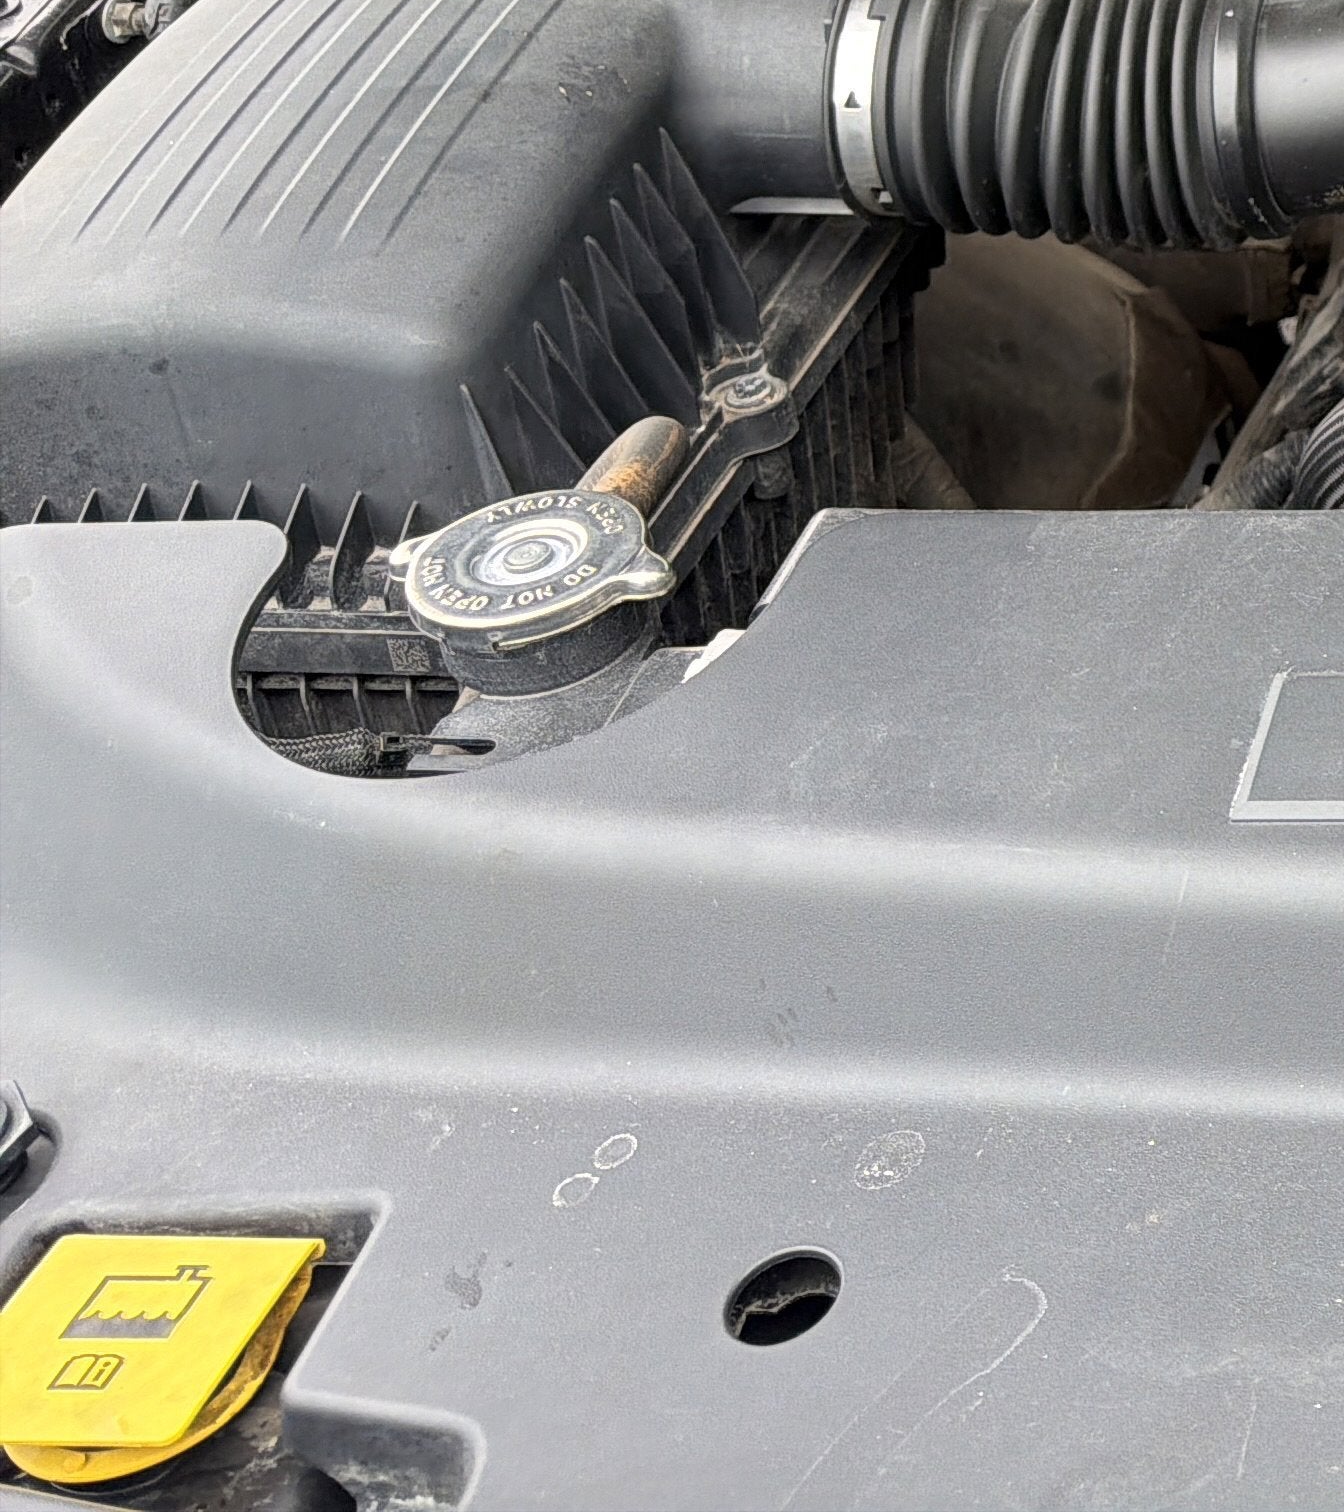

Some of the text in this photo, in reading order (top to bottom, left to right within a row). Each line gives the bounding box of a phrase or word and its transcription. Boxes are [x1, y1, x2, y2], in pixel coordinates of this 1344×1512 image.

[487, 496, 583, 523] SLOWLY
[422, 556, 598, 611] DO NOT OPEN HOT
